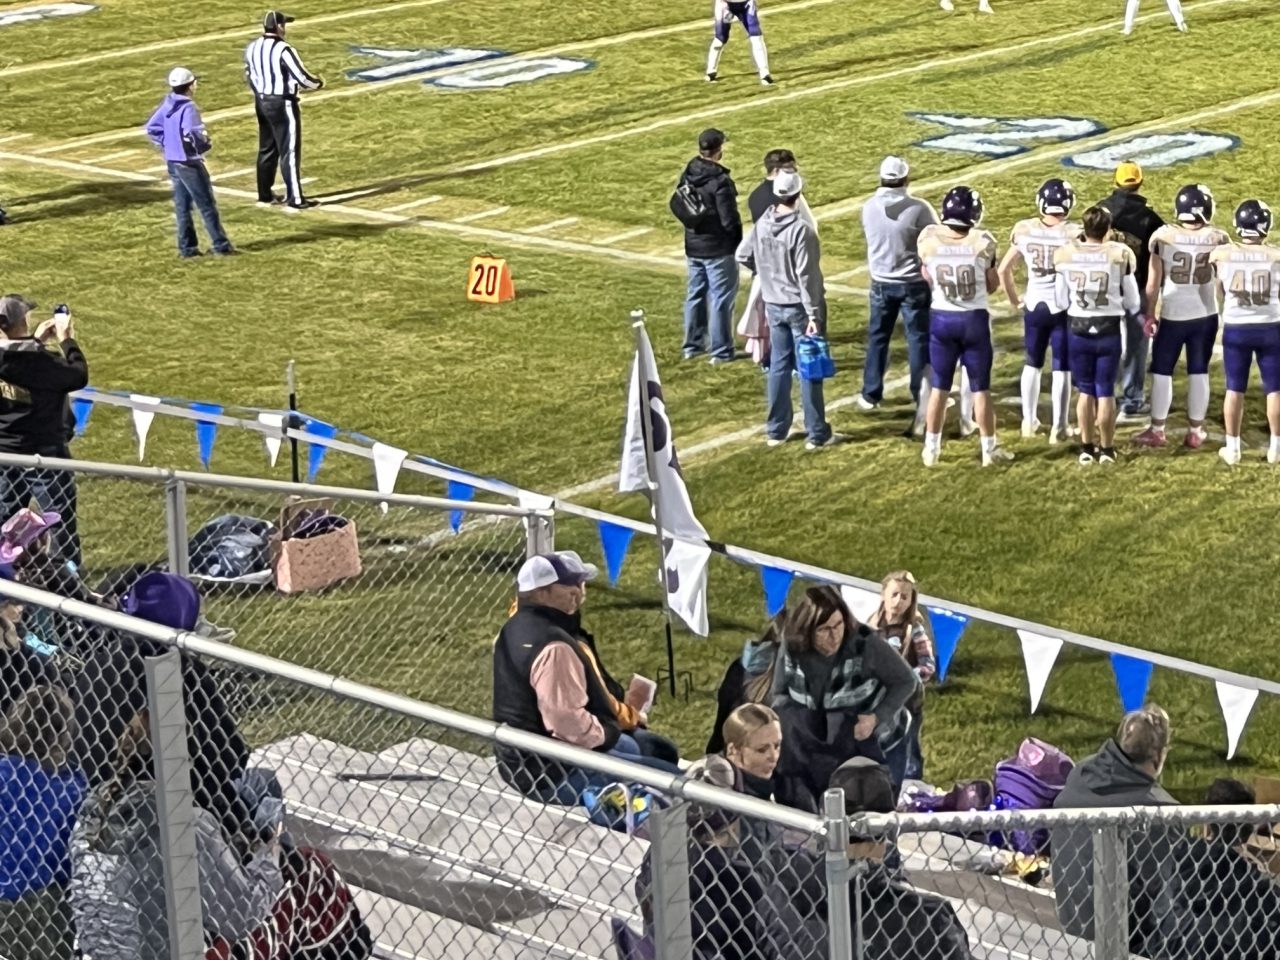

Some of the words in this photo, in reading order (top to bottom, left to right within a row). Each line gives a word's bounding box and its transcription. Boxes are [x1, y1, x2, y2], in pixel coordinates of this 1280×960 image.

[472, 263, 498, 297] 20
[936, 264, 976, 302] 60
[1229, 269, 1271, 306] 40
